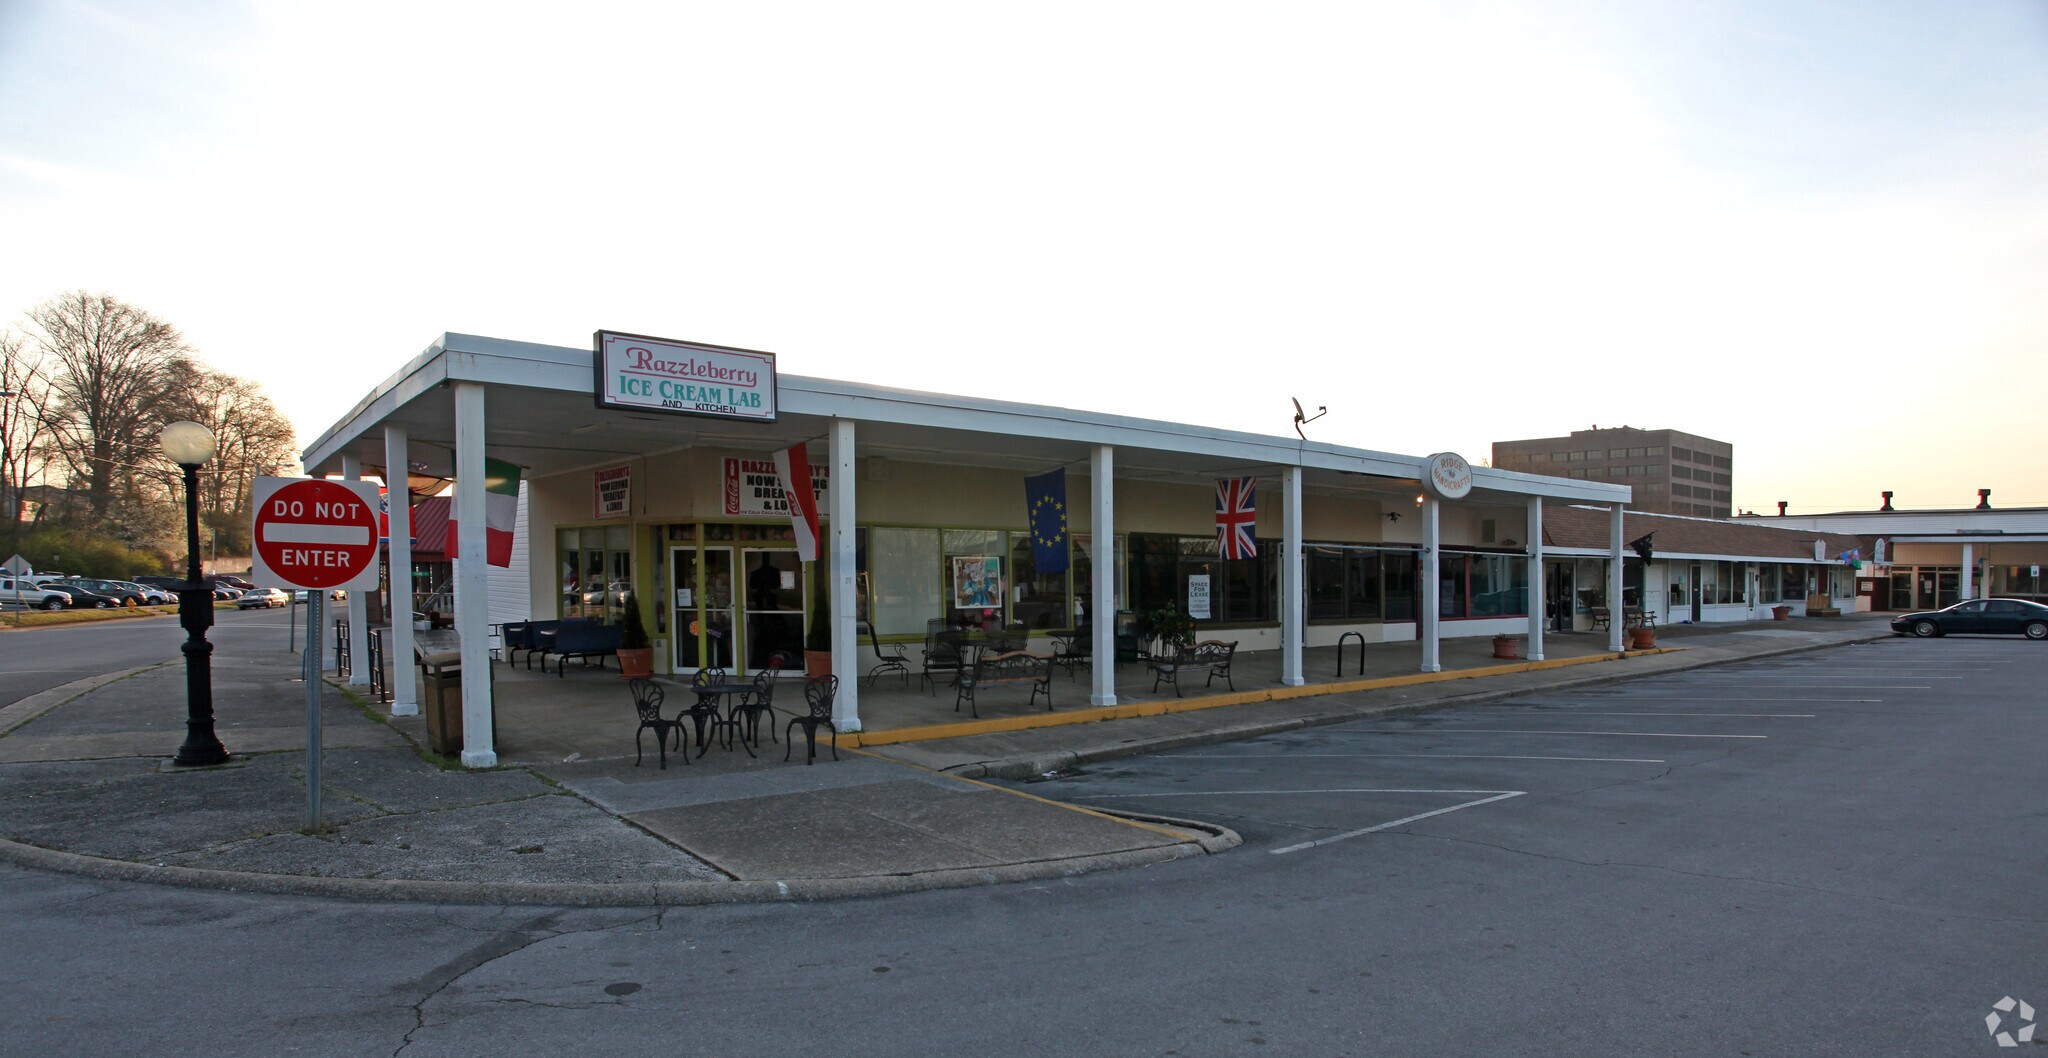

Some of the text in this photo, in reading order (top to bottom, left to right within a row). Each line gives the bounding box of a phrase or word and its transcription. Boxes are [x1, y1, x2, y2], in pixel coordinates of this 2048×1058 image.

[626, 347, 757, 387] Razzleberry
[620, 376, 761, 407] ICE CREAM LAB
[695, 403, 736, 414] KITCHEN
[1440, 458, 1463, 472] RIDGE
[747, 475, 775, 487] NOW
[1434, 468, 1470, 490] HANDICRAFTS
[274, 500, 360, 519] DO NOT
[282, 549, 350, 567] ENTER
